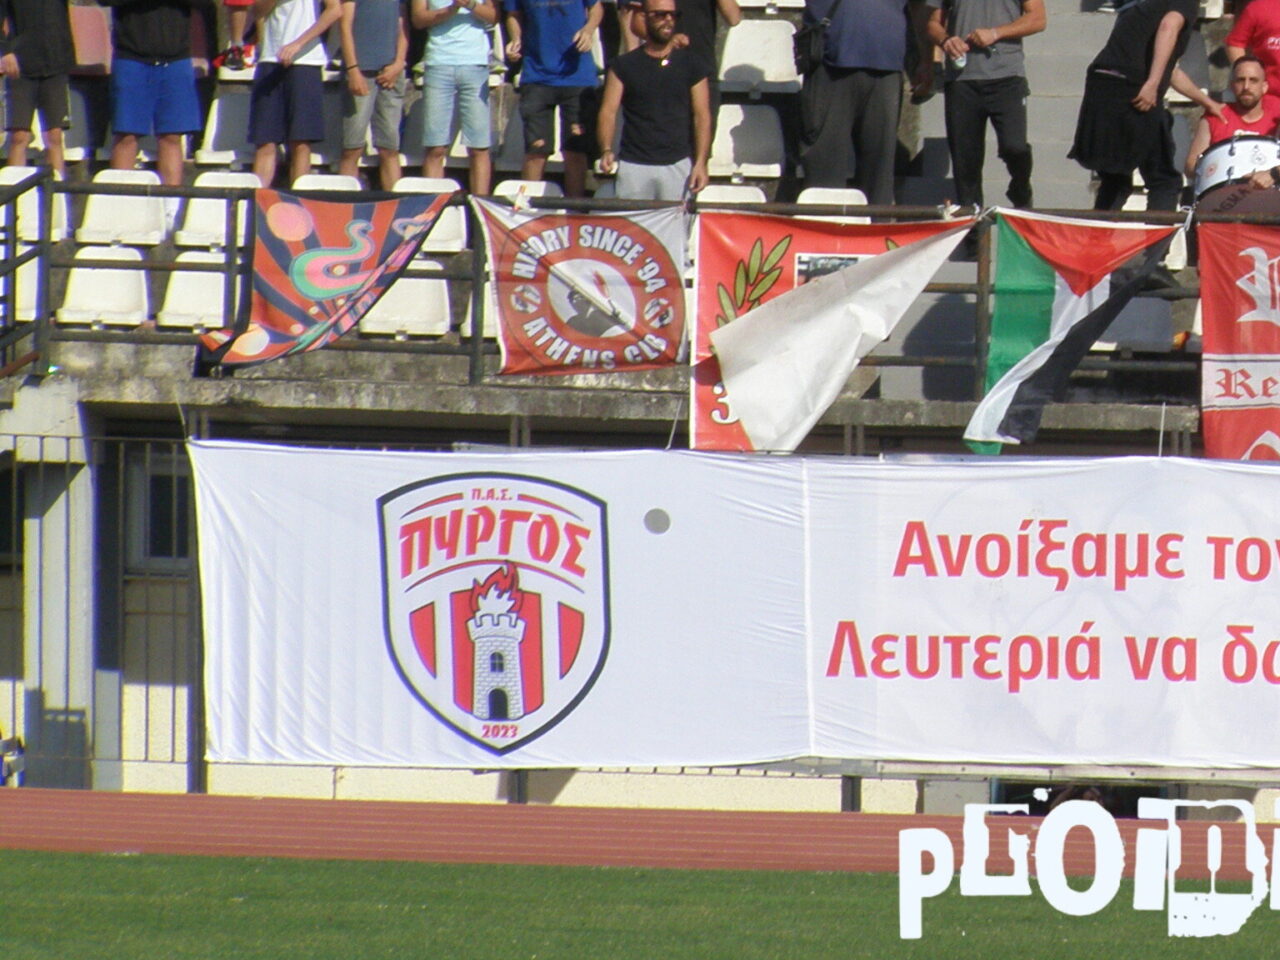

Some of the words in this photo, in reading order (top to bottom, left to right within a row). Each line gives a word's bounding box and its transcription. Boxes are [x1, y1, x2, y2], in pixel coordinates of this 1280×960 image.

[579, 224, 645, 266] SINCE
[522, 316, 616, 370] ATHENS
[623, 332, 668, 363] CLB
[399, 504, 591, 580] ΠΥΡΓΟΣ
[893, 518, 1185, 592] Ανοίξαμε
[825, 619, 1101, 694] Λευτεριά
[1124, 636, 1197, 683] να
[482, 724, 518, 738] 2023
